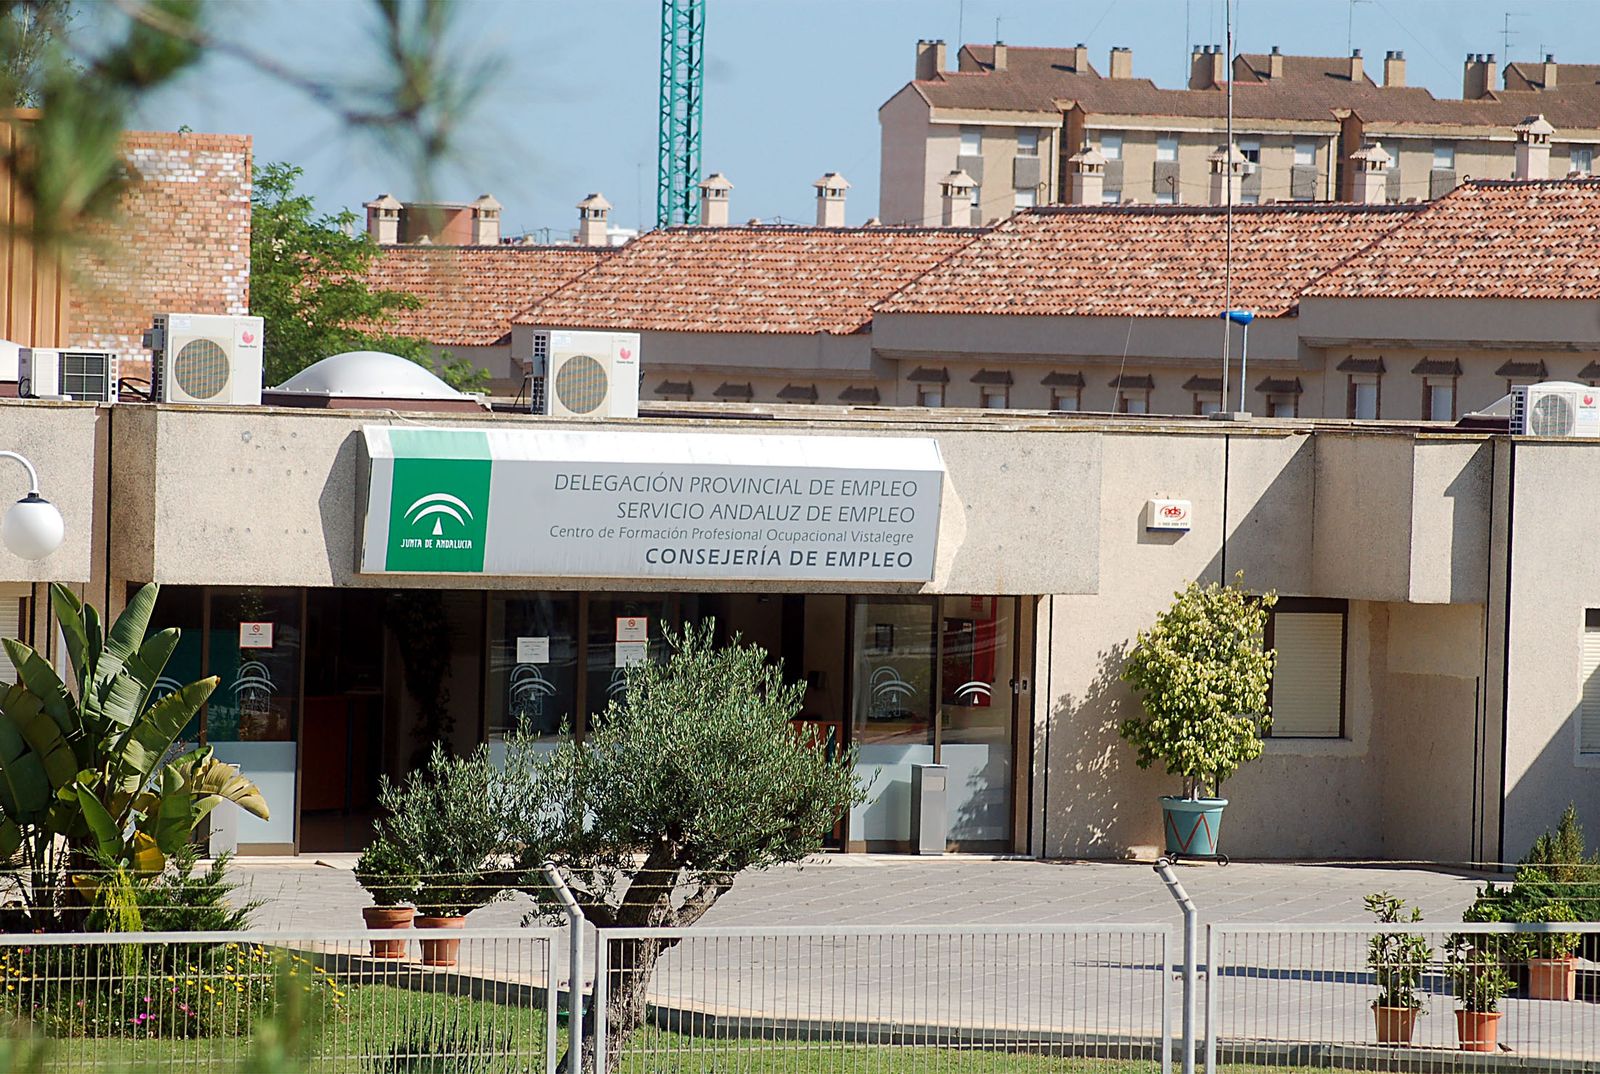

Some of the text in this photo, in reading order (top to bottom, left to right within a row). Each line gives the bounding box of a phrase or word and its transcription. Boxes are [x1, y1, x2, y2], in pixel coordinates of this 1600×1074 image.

[554, 471, 918, 497] DELEGACIÓN PROVINCIAL DE EMPLEO
[617, 501, 915, 523] SERVICIO ANDALUZ DE EMPLEO
[1164, 506, 1181, 515] ads
[400, 538, 422, 548] JUNTA
[424, 538, 433, 548] DE
[549, 525, 914, 546] Centro de Formación Profesional Ocupacional Vistalegre
[646, 545, 913, 568] CONSEJERÍA DE EMPLEO
